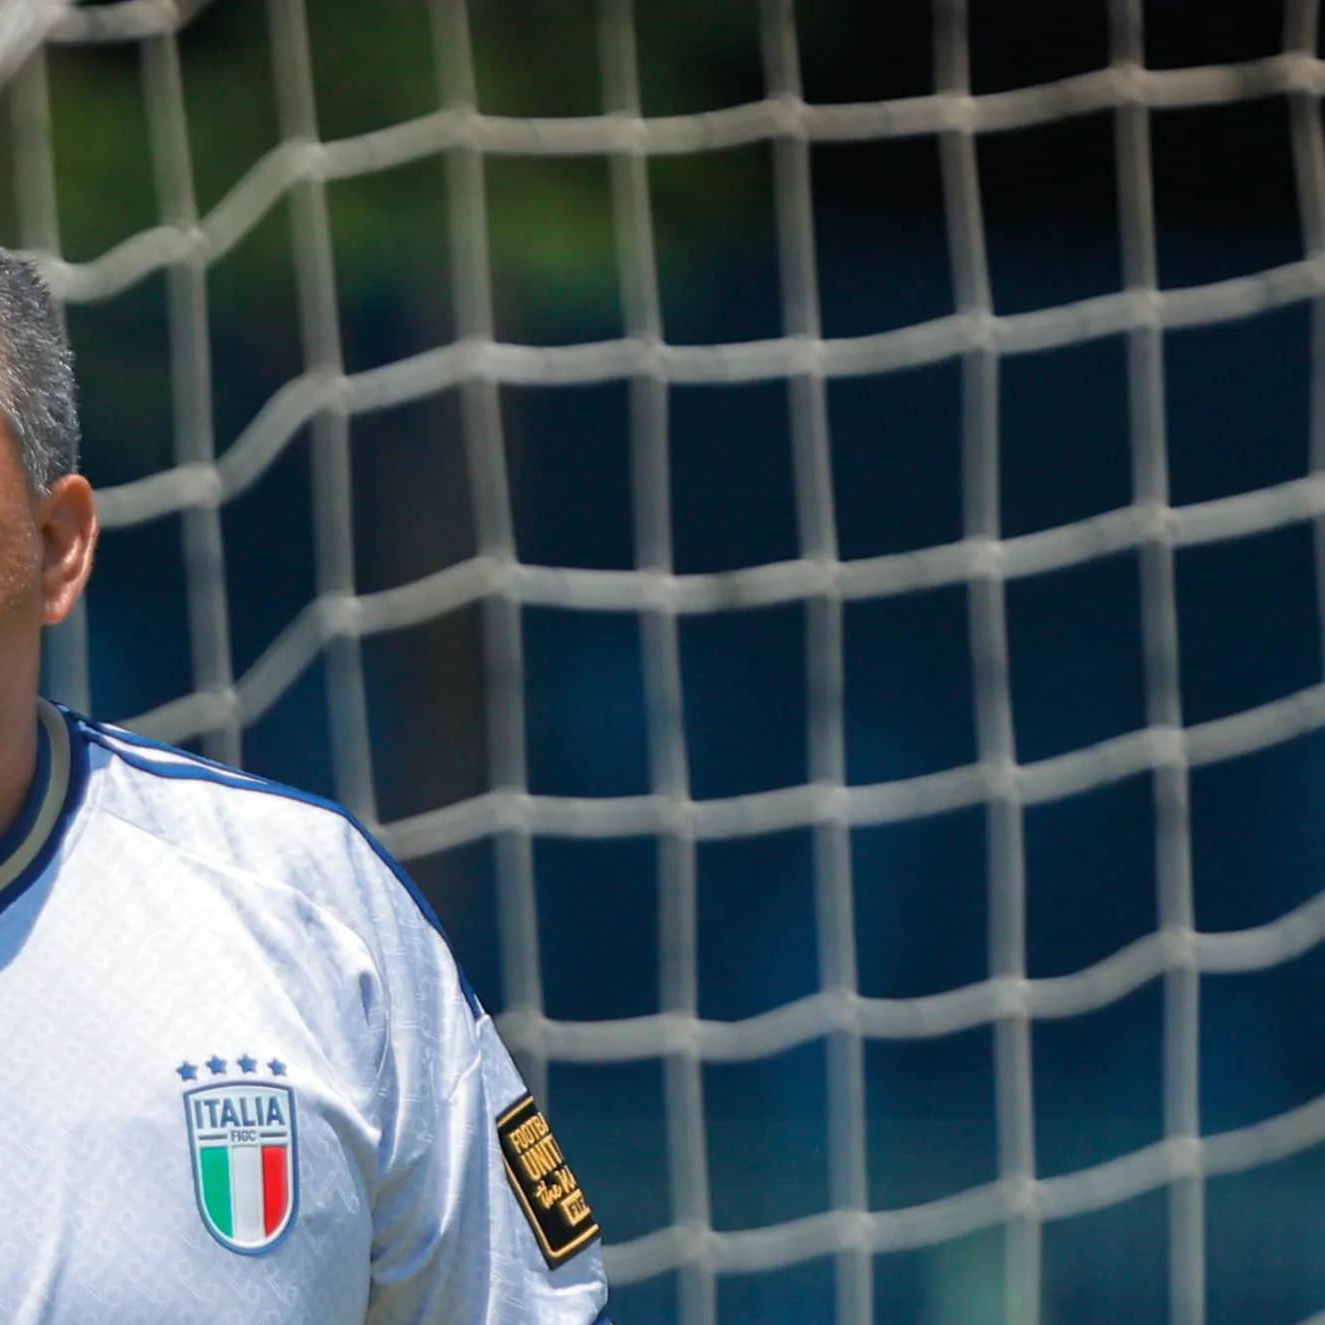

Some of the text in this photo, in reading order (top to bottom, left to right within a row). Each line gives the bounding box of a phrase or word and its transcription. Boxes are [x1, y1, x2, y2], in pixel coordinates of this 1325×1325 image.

[194, 1096, 285, 1129] ITALIA
[231, 1129, 257, 1142] FIGC
[520, 1133, 565, 1181] UNIT
[535, 1180, 563, 1209] the
